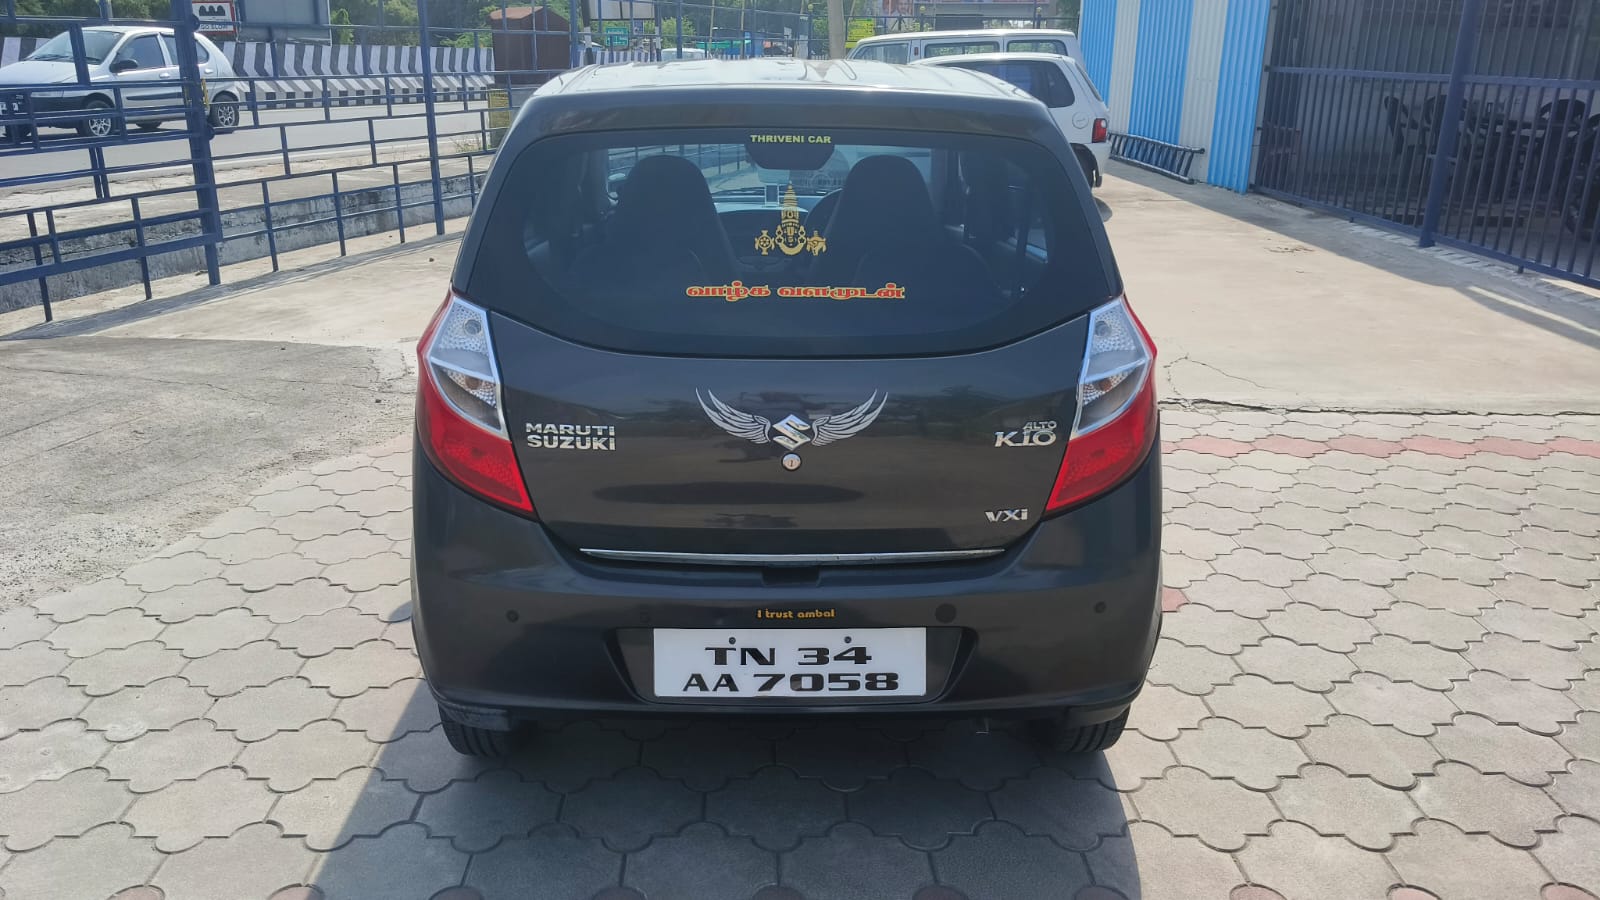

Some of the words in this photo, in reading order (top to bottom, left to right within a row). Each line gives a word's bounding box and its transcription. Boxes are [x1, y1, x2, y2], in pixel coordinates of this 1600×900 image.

[750, 134, 804, 143] THRIVENI
[807, 135, 832, 144] CAR
[686, 280, 771, 302] வாழ்க
[777, 282, 906, 299] வளமுடன்
[525, 422, 615, 436] MARUTI
[1022, 420, 1057, 430] ALTO
[527, 435, 616, 451] SUZUKI
[994, 430, 1057, 447] K10
[757, 609, 762, 618] I
[765, 608, 793, 618] trust
[797, 608, 835, 618] ambal
[705, 647, 776, 665] TN
[797, 646, 872, 665] 34
[682, 673, 739, 692] AA
[753, 672, 899, 692] 7058
